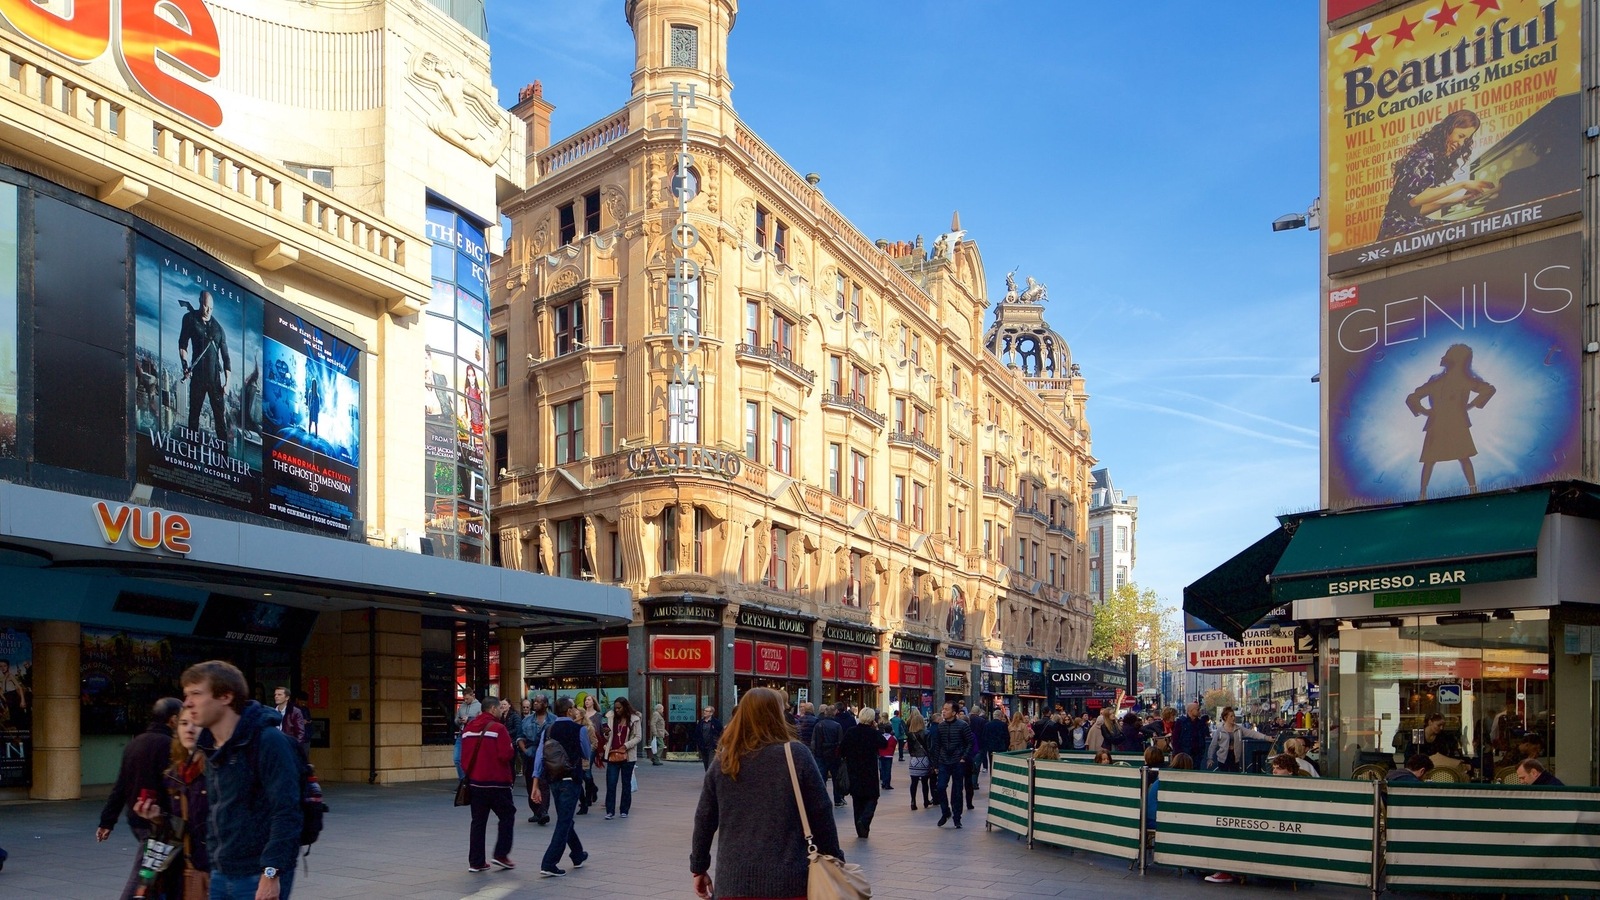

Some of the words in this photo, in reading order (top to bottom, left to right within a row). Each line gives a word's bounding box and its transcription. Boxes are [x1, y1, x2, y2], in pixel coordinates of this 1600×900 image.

[1344, 1, 1558, 112] Beautiful
[1344, 110, 1375, 129] The
[1377, 87, 1434, 117] Carole
[1436, 71, 1480, 99] King
[1483, 43, 1558, 84] Musical
[1345, 127, 1376, 150] WILL
[1380, 117, 1406, 139] YOU
[1411, 105, 1443, 129] LOVE
[1472, 67, 1558, 110] TOMORROW
[1493, 102, 1509, 115] THE
[1509, 94, 1534, 111] EARTH
[1535, 87, 1558, 103] MOVE
[1501, 111, 1523, 130] TOO
[1345, 149, 1362, 162] TAKE
[1362, 143, 1381, 156] GOOD
[1382, 137, 1400, 150] CARE
[1401, 134, 1411, 144] OF
[1345, 158, 1371, 173] YOU'VE
[1371, 152, 1386, 165] GOT
[1387, 151, 1393, 160] A
[1345, 171, 1364, 188] ONE
[1366, 163, 1388, 181] FINE
[1345, 202, 1354, 213] UP
[1355, 200, 1365, 210] ON
[1366, 195, 1379, 207] THE
[1392, 225, 1466, 255] ALDWYCH
[1471, 205, 1543, 235] THEATRE
[465, 237, 484, 262] BIG
[669, 82, 702, 424] HIPPODROME
[164, 258, 188, 276] VIN
[197, 275, 240, 303] DIESEL
[1330, 286, 1356, 302] RSC
[1338, 265, 1573, 353] GENIUS
[178, 424, 200, 444] THE
[202, 431, 227, 452] LAST
[149, 428, 198, 461] WITCH
[200, 445, 253, 478] HUNTER
[627, 445, 741, 479] CASINO
[164, 455, 202, 472] WEDNESDAY
[203, 467, 231, 481] OCTOBER
[272, 450, 321, 473] PARANORMAL
[322, 468, 352, 483] ACTIVITY
[273, 459, 289, 473] THE
[289, 465, 313, 482] GHOST
[314, 473, 351, 494] DIMENSION
[308, 481, 319, 493] 3D
[92, 500, 192, 554] vue
[286, 508, 312, 520] CINEMAS
[311, 514, 327, 525] FROM
[1328, 575, 1415, 594] ESPRESSO
[1430, 570, 1466, 585] BAR
[653, 606, 715, 618] AMUSEMENTS
[741, 612, 777, 629] CRYSTAL
[779, 619, 805, 633] ROOMS
[225, 630, 247, 640] NOW
[247, 633, 278, 645] SHOWING
[827, 626, 855, 641] CRYSTAL
[855, 631, 876, 645] ROOMS
[893, 638, 914, 651] CRYSTAL
[1224, 641, 1237, 649] THE
[664, 648, 702, 660] SLOTS
[761, 647, 783, 660] CRYSTAL
[1200, 650, 1219, 658] HALF
[1221, 648, 1245, 657] PRICE
[1201, 657, 1236, 667] THEATRE
[1238, 656, 1266, 665] TICKET
[1268, 655, 1298, 664] BOOTH
[764, 660, 780, 672] BINGO
[1051, 672, 1091, 682] CASINO
[1216, 817, 1270, 830] ESPRESSO
[1279, 822, 1302, 833] BAR
